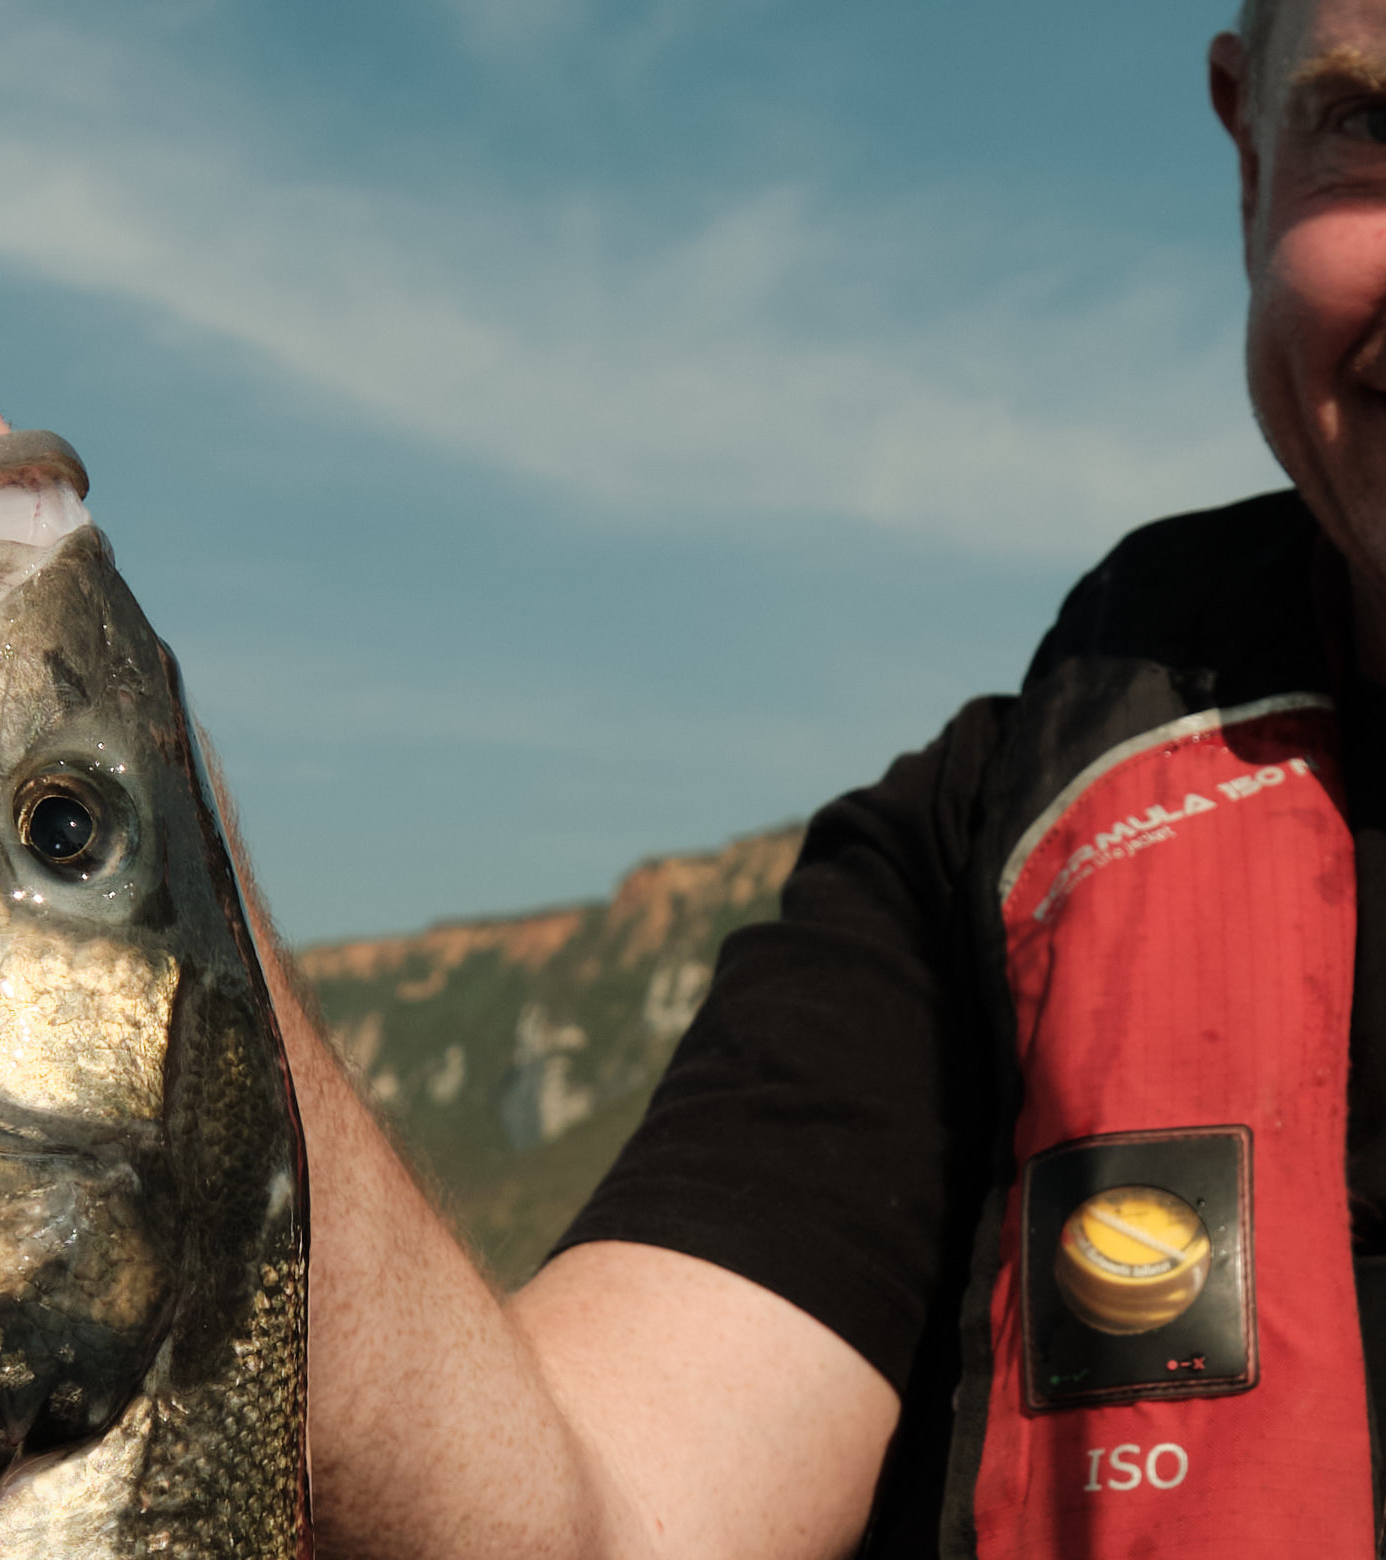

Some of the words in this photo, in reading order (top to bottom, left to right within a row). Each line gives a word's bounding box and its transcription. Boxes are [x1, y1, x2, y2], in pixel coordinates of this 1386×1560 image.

[1032, 793, 1218, 920] FORMULA
[1216, 766, 1285, 802] 150
[1083, 1442, 1189, 1492] ISO
